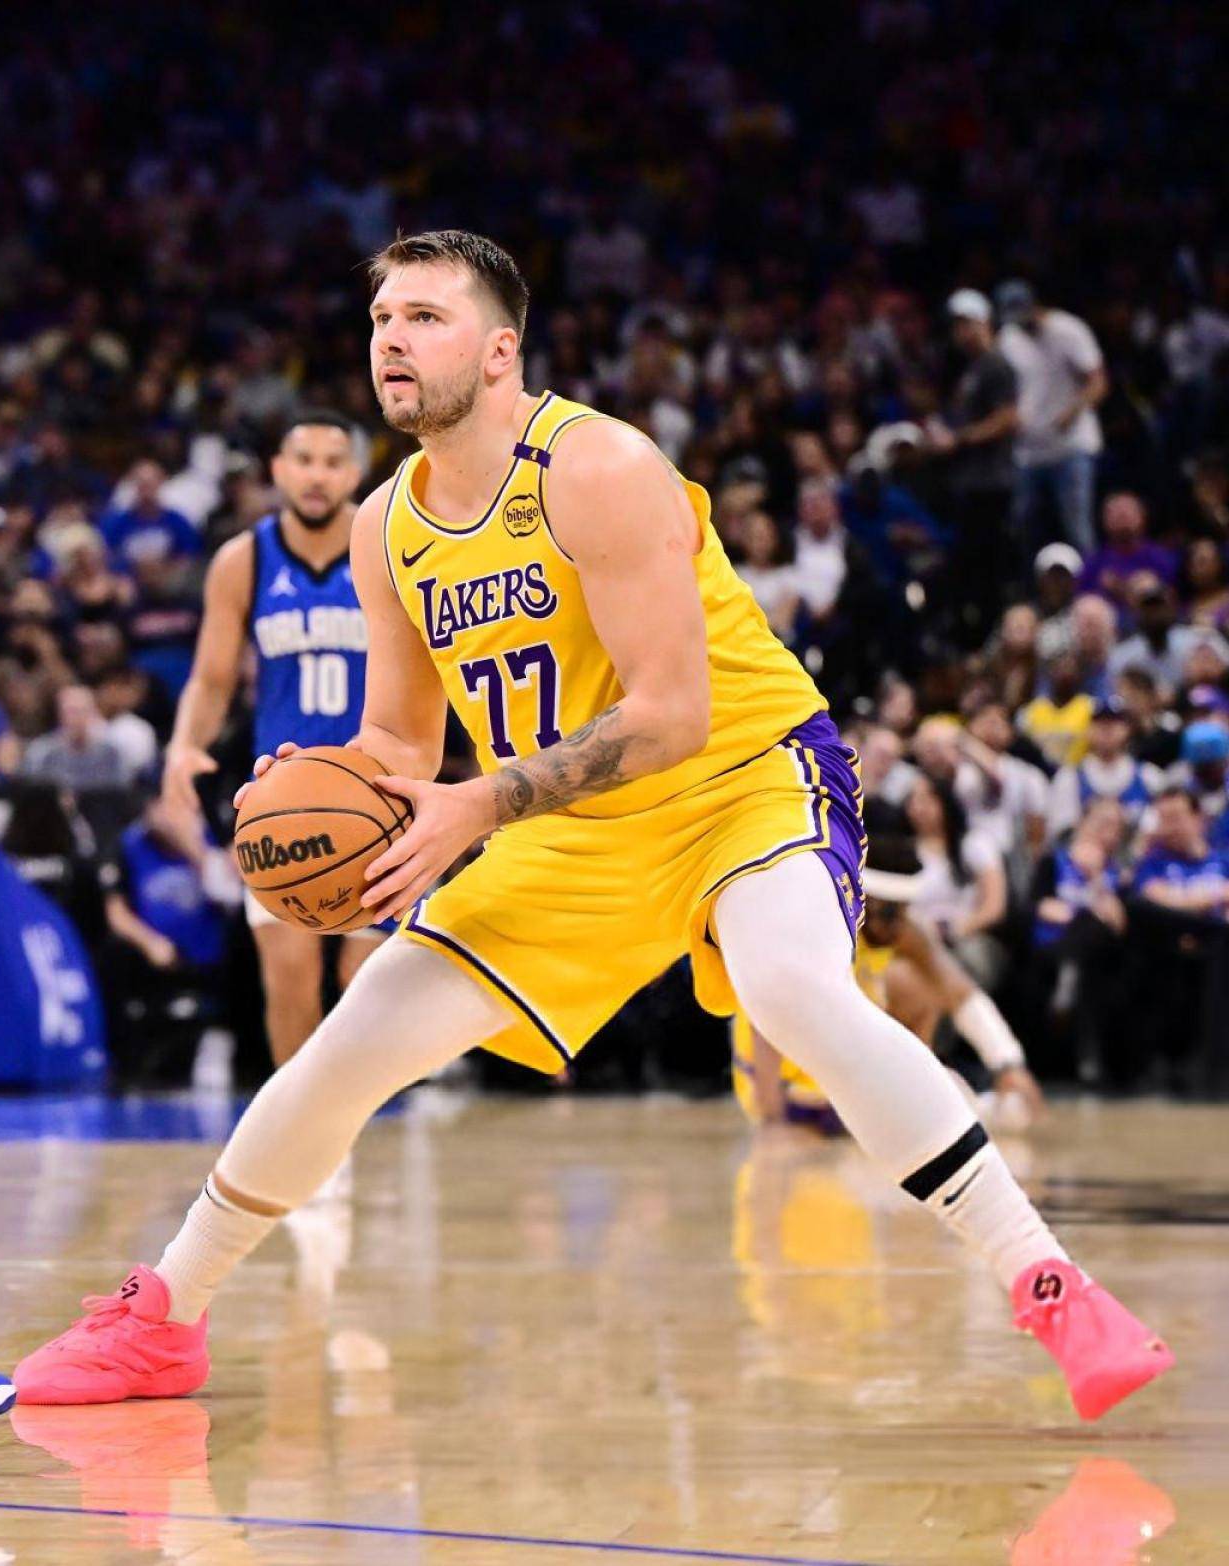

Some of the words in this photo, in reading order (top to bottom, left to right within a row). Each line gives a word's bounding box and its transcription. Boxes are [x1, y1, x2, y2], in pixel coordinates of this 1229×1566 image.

[506, 506, 539, 523] bibigo
[416, 562, 558, 650] LAKERS
[298, 652, 348, 716] 10
[458, 641, 563, 760] 77
[237, 834, 336, 874] Wilson
